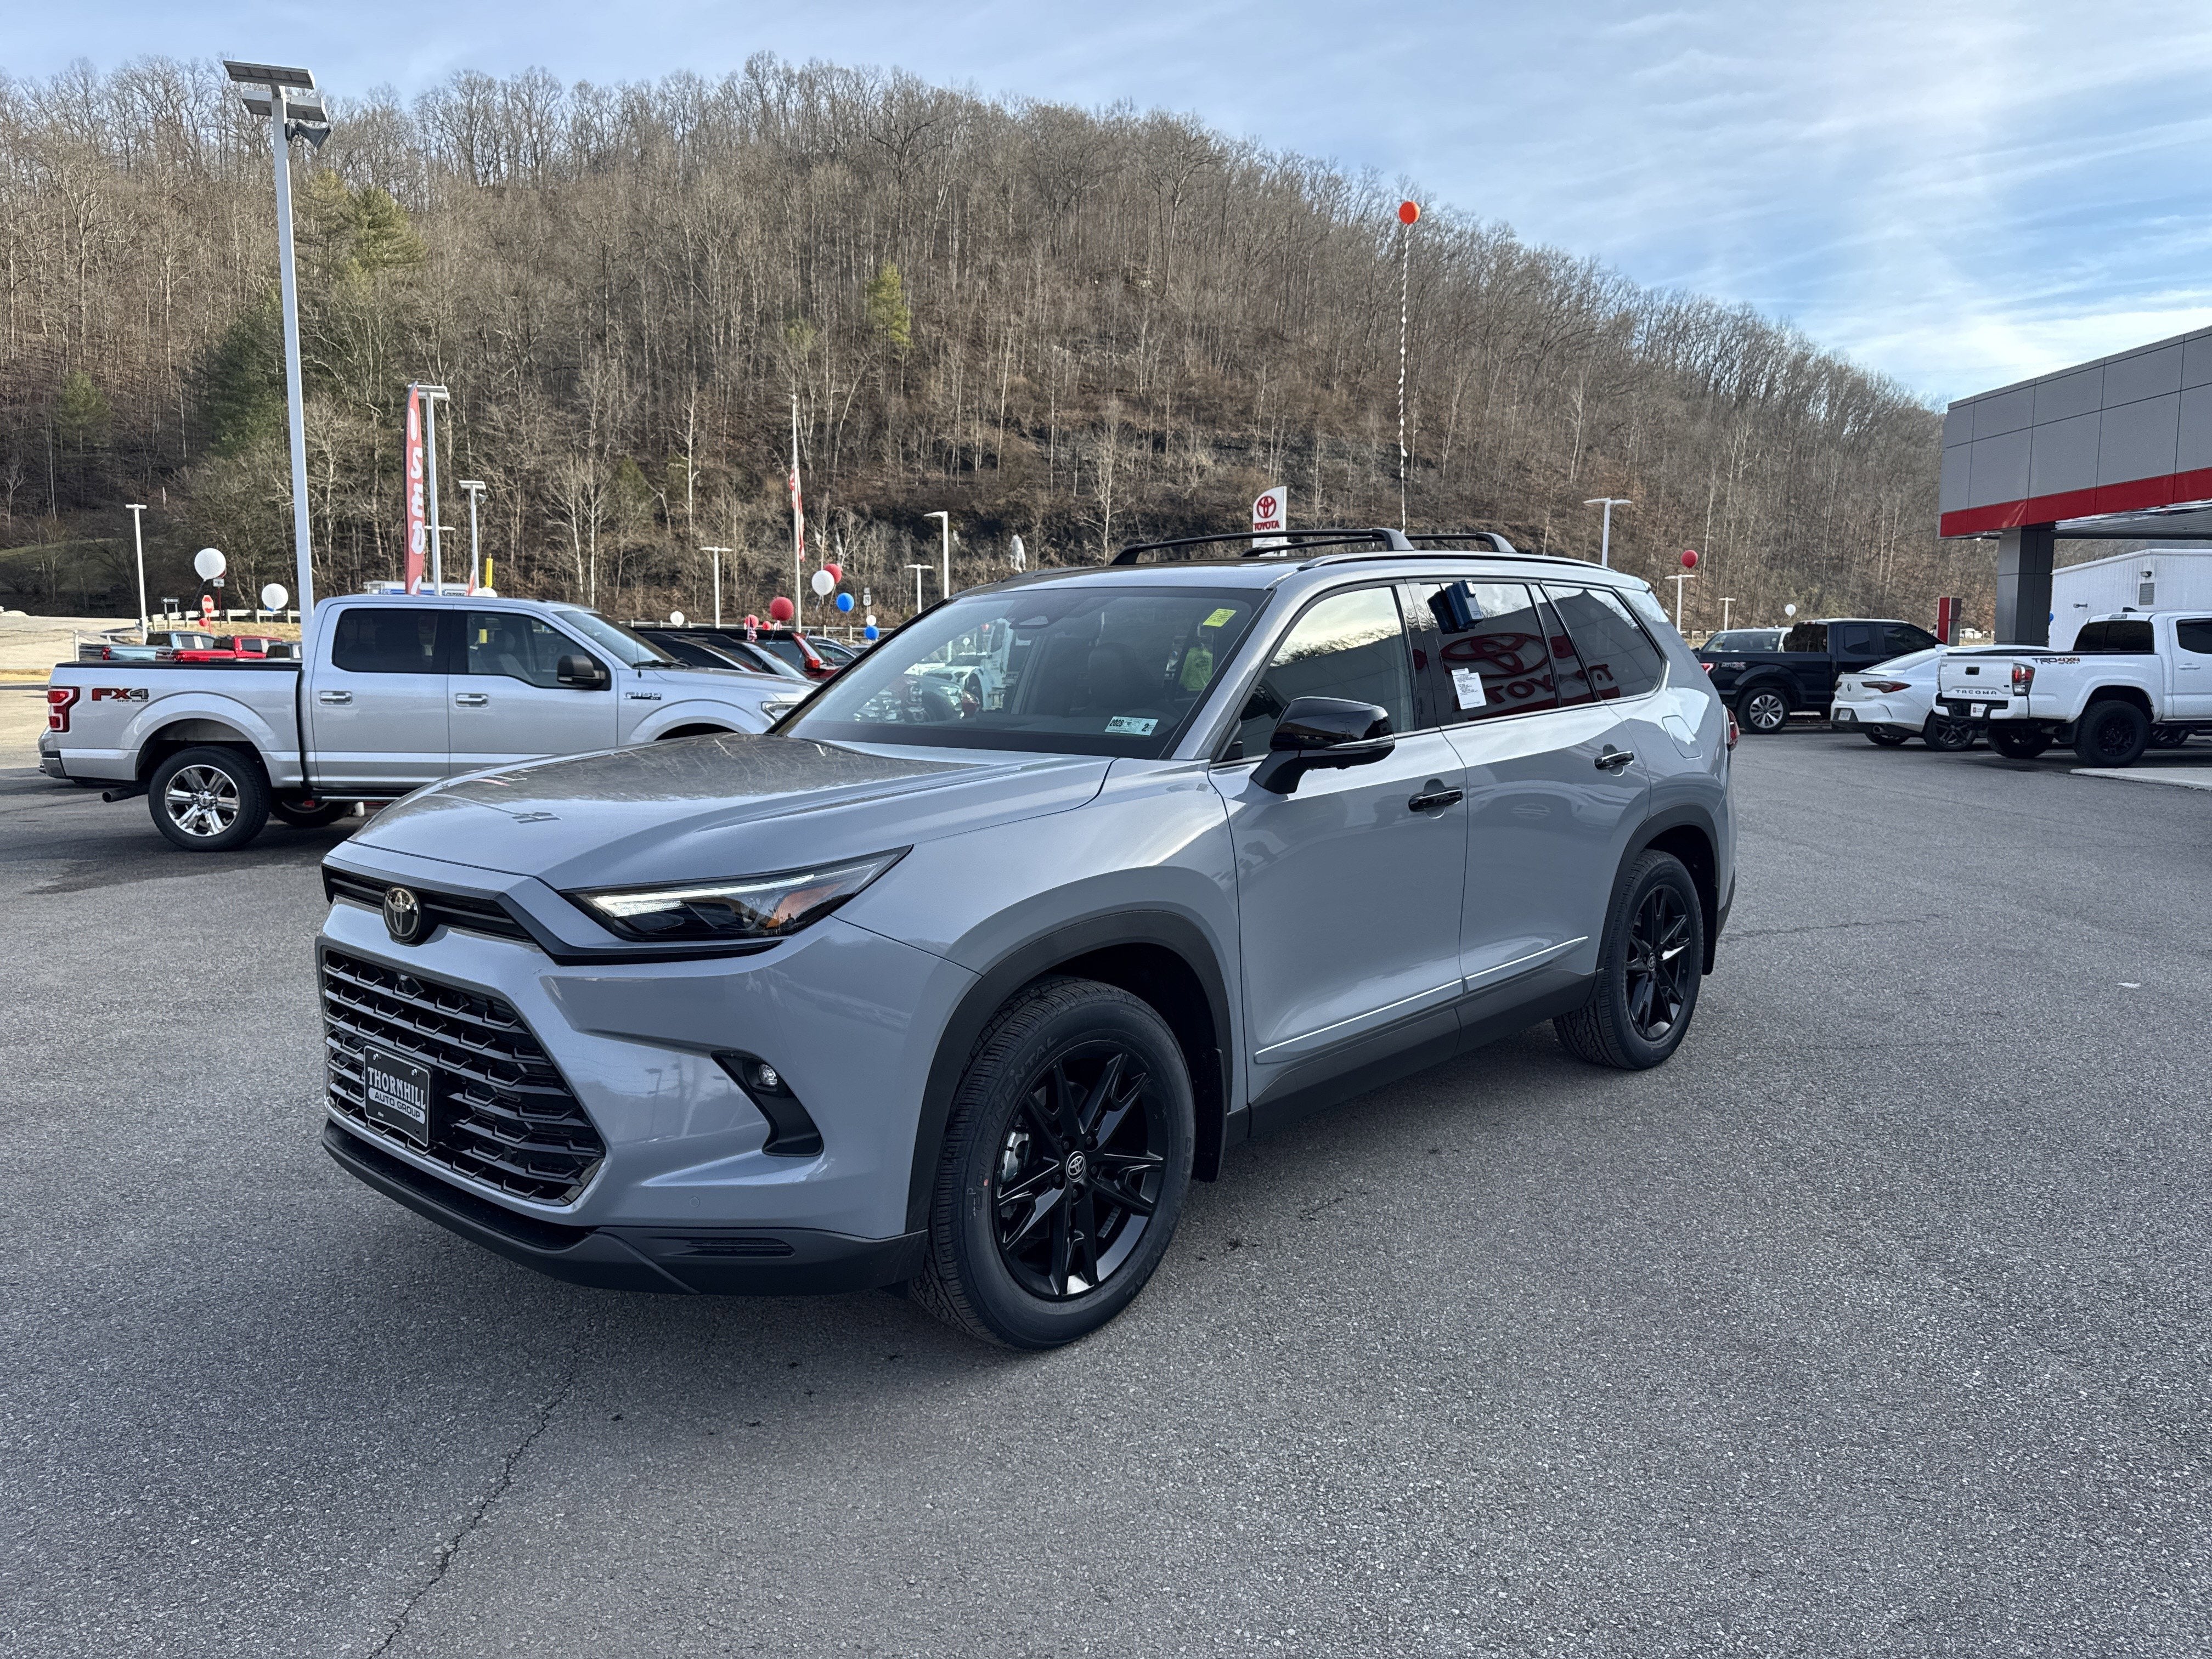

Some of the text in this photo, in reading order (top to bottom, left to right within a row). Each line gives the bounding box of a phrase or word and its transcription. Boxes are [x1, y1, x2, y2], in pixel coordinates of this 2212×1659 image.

[1254, 520, 1280, 531] TOYOTA
[92, 688, 149, 701] FX4
[1141, 723, 1149, 732] 2
[367, 1066, 426, 1110] THORNHILL
[375, 1092, 420, 1119] AUTO GROUP
